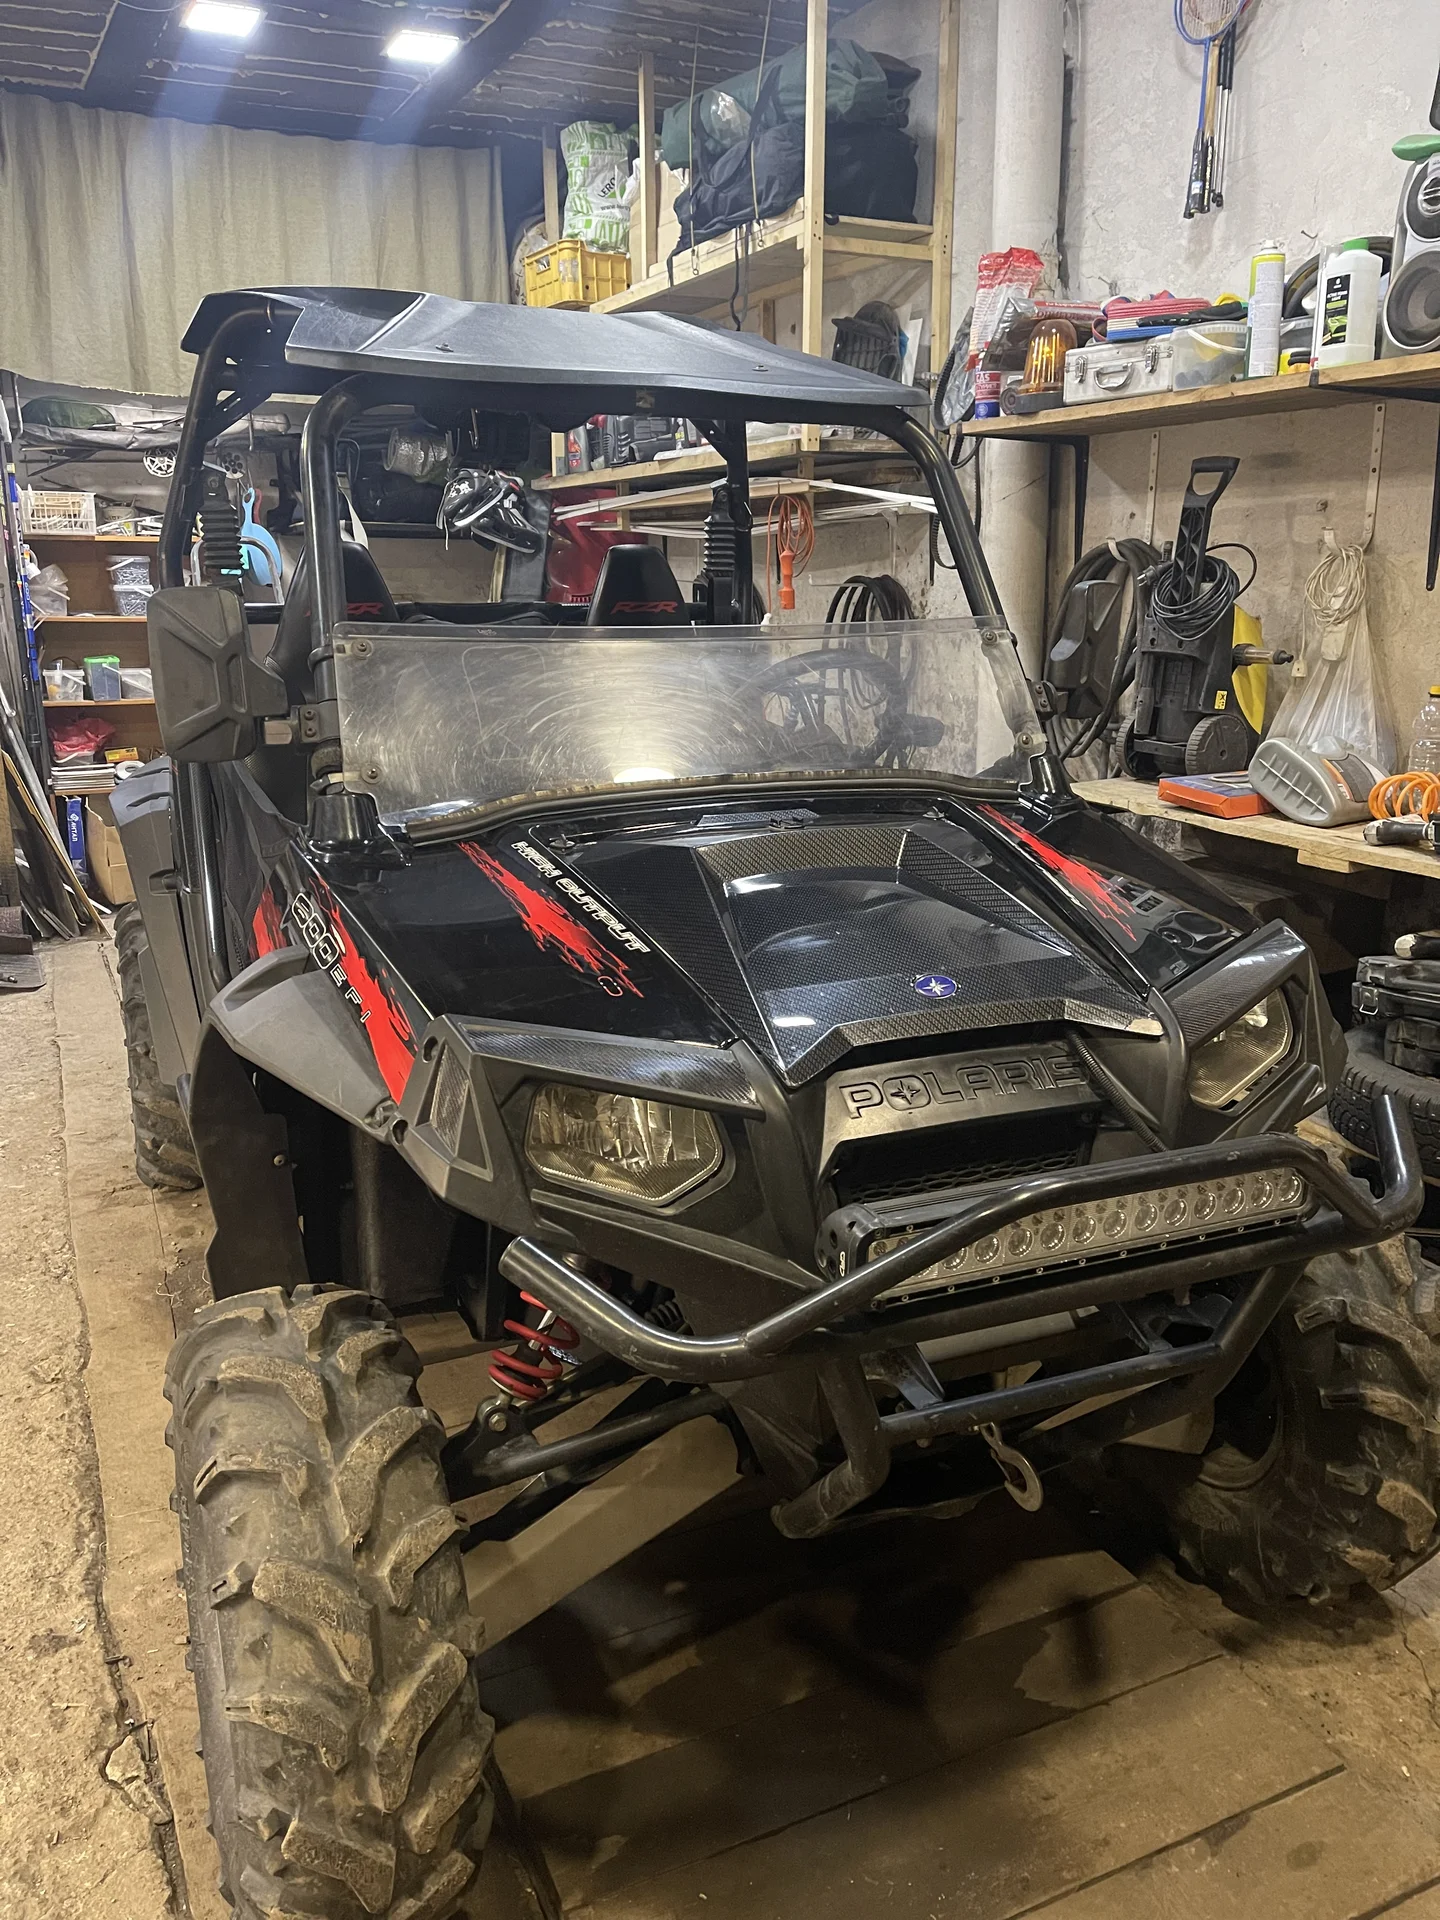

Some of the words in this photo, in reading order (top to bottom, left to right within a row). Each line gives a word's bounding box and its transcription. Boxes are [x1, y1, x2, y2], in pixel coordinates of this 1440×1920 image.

[609, 601, 678, 615] RZR
[291, 892, 340, 970] 800
[511, 841, 563, 878] HIGH
[555, 877, 652, 953] OUTPUT
[839, 1054, 1087, 1119] POLARIS
